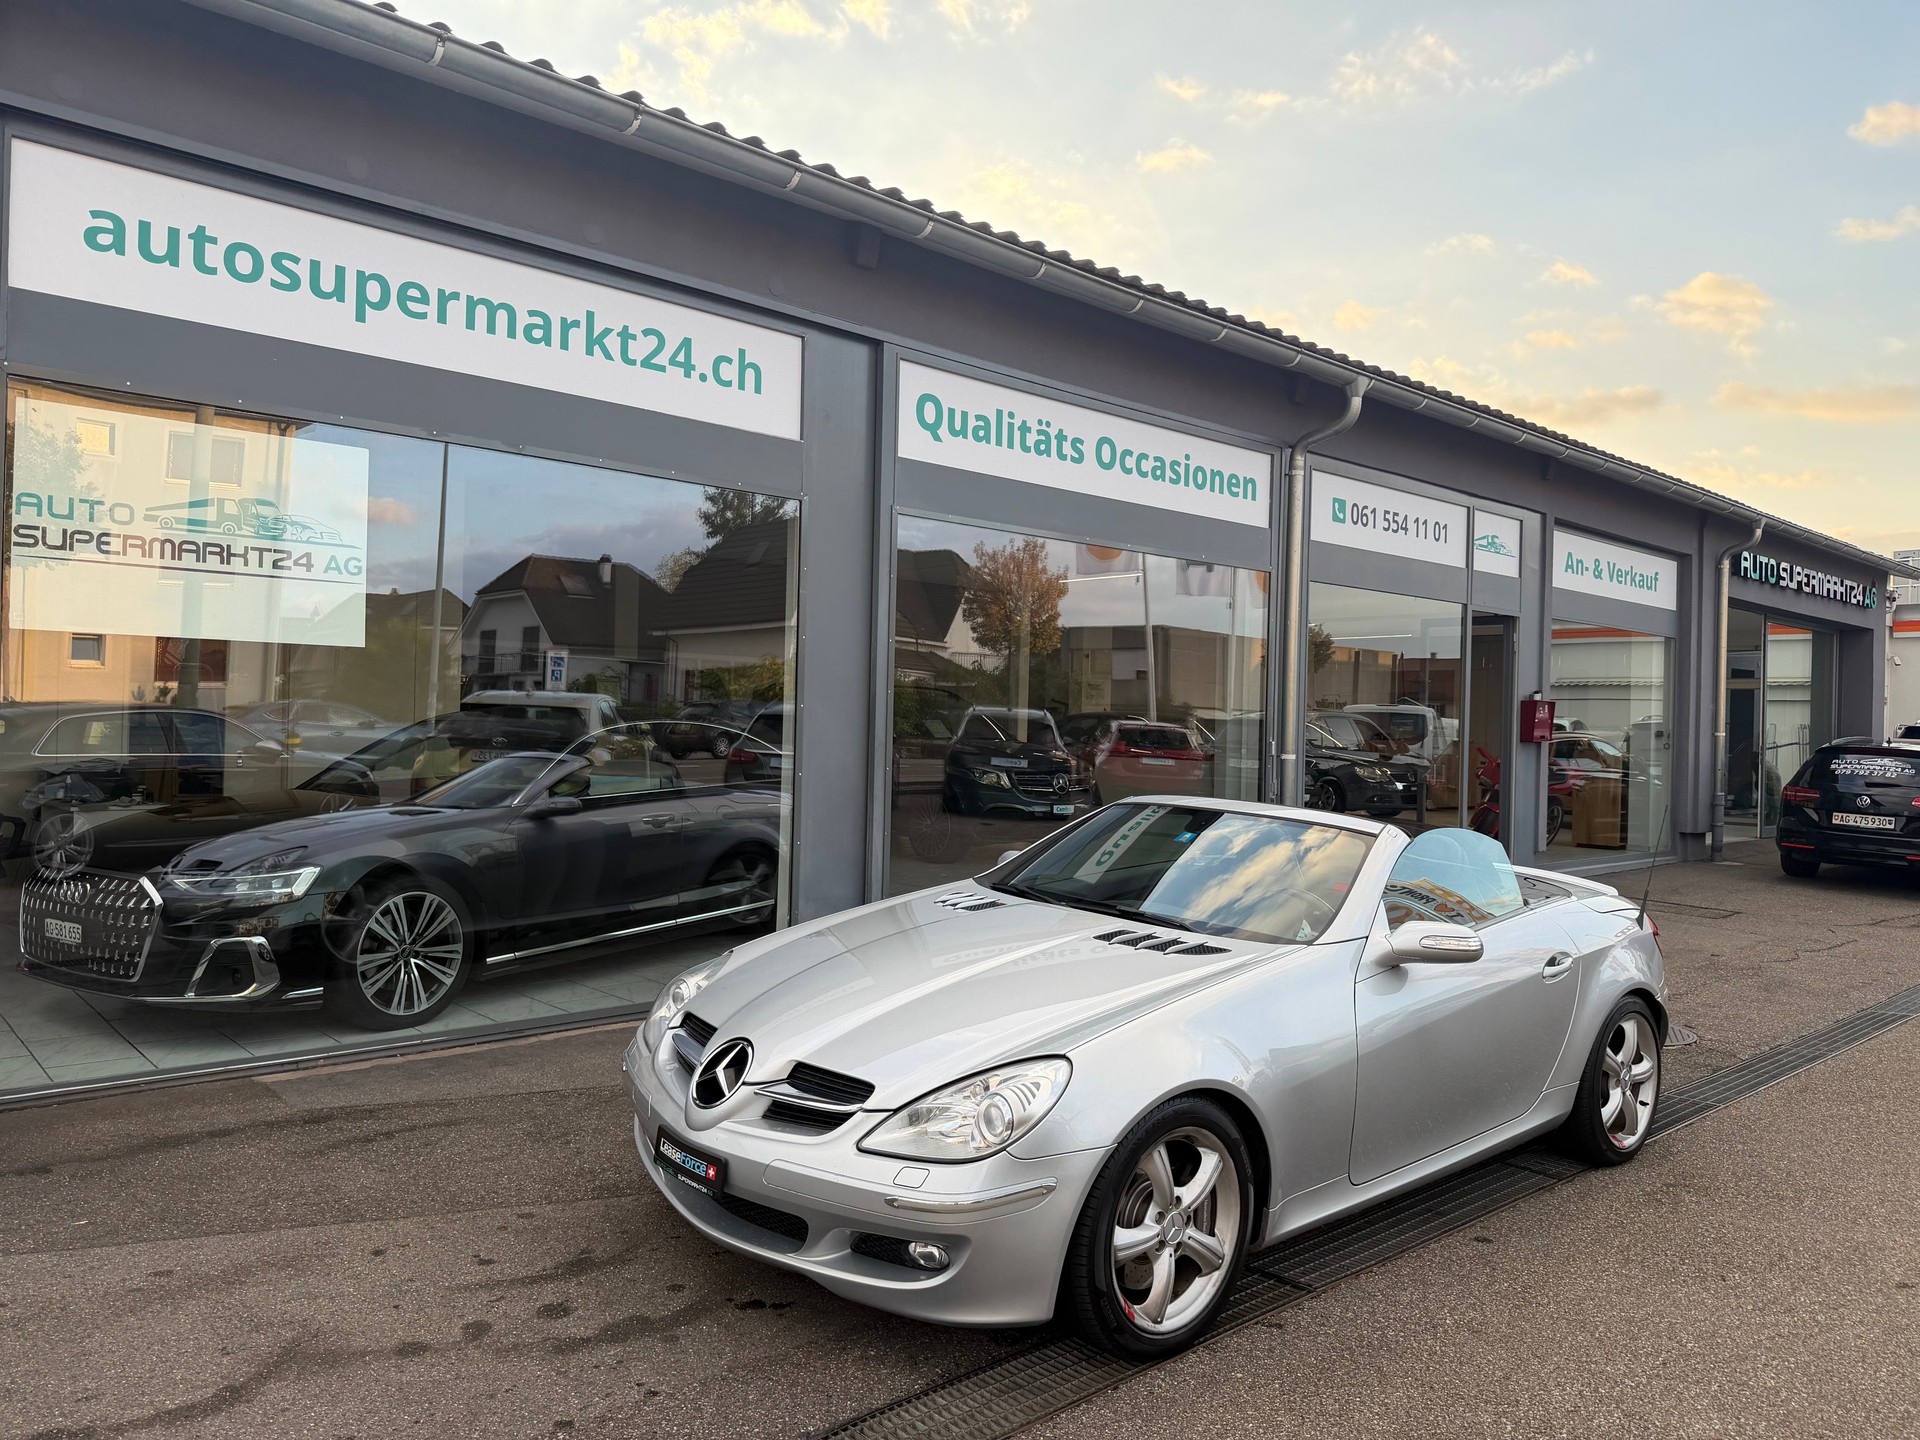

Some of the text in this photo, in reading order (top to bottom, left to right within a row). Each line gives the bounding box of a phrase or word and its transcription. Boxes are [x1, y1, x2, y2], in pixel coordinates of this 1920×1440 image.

[83, 208, 764, 395] autosupermarkt24.ch
[916, 393, 1257, 502] Qualitäts Occasionen
[15, 491, 135, 526] AUTO
[1350, 502, 1448, 544] 061 554 11 01
[12, 524, 363, 577] SUPERMARKT24 AG
[1565, 551, 1659, 592] An- & Verkauf
[1741, 551, 1877, 609] AUTO SUPERMARKT24 AG
[1830, 764, 1902, 772] SUPERMARKT24
[660, 1137, 707, 1177] LeaseForce
